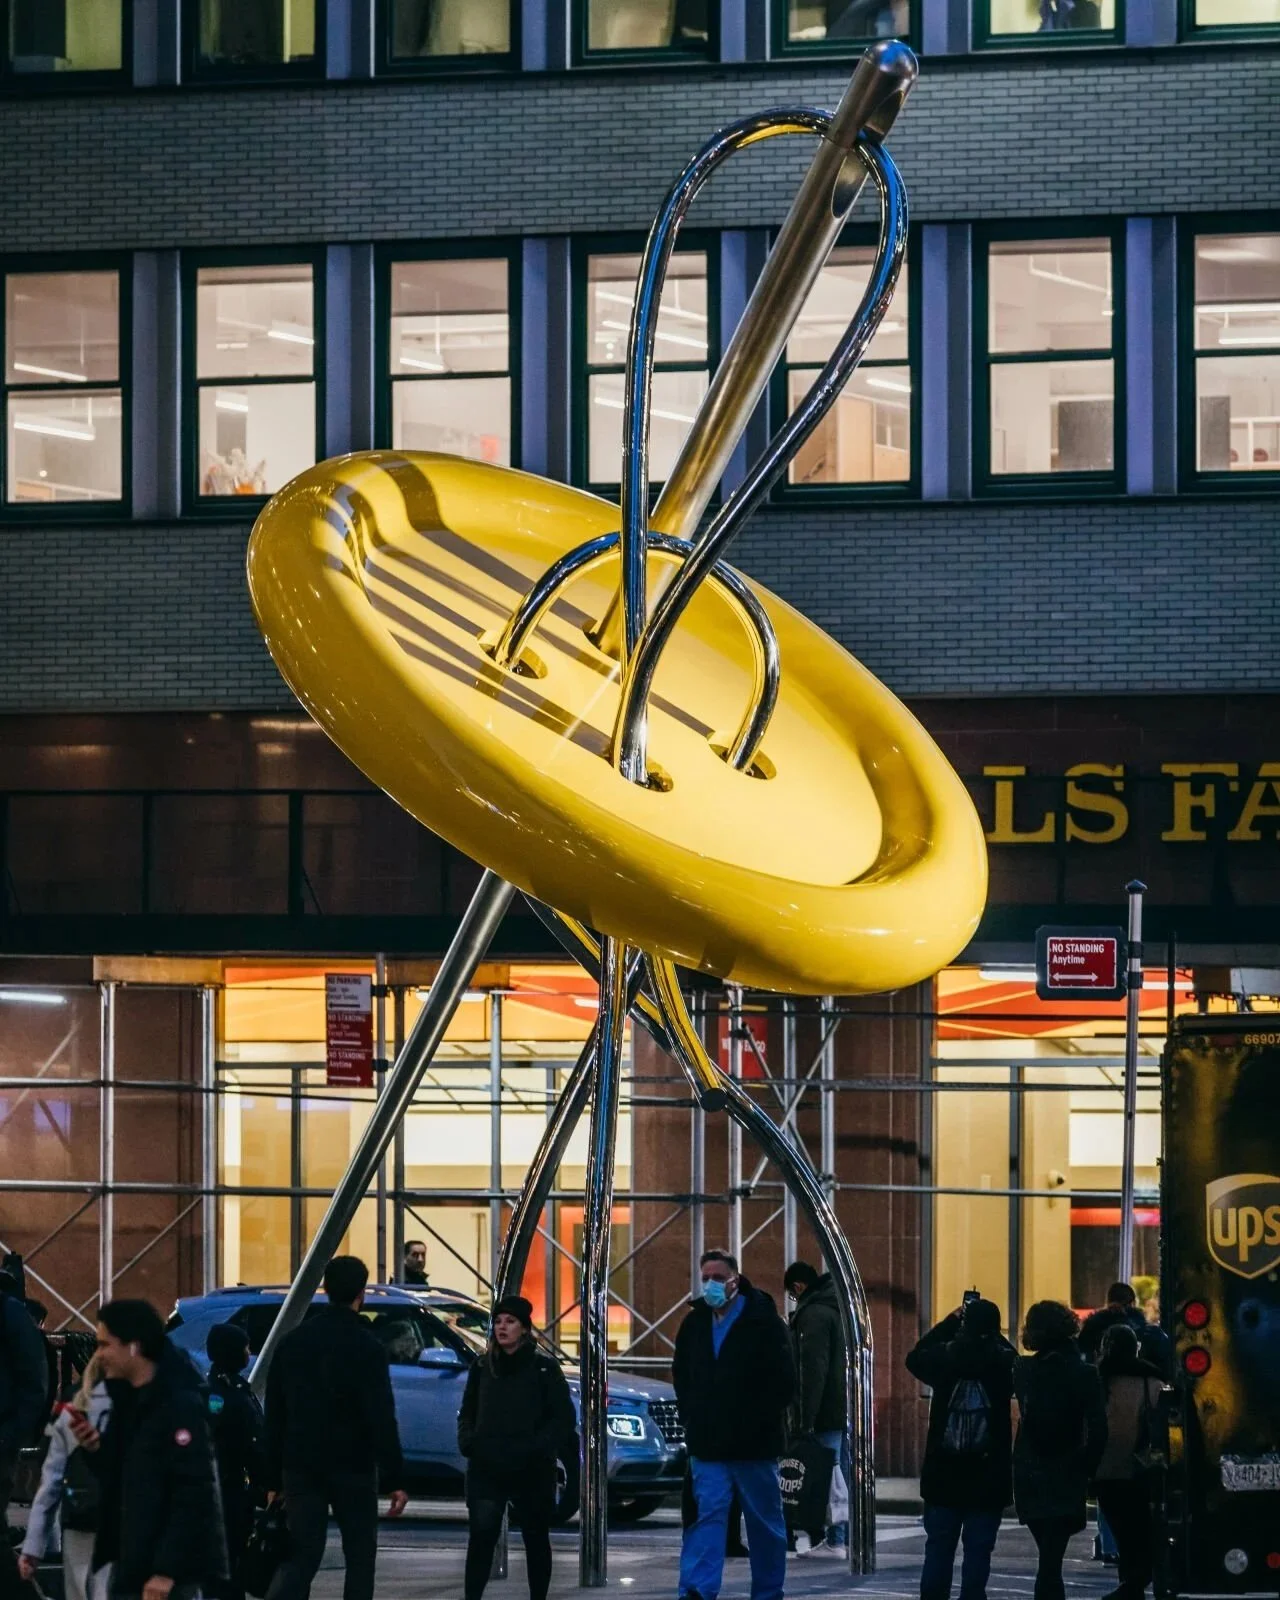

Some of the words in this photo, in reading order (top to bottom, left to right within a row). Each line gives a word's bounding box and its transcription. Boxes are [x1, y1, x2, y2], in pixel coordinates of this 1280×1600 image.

[1052, 943, 1064, 953] NO
[1065, 943, 1105, 954] STANDING
[1052, 954, 1086, 966] Anytime
[338, 1052, 366, 1060] STANDING
[329, 1060, 352, 1069] Anytime
[779, 1476, 804, 1493] OOPS
